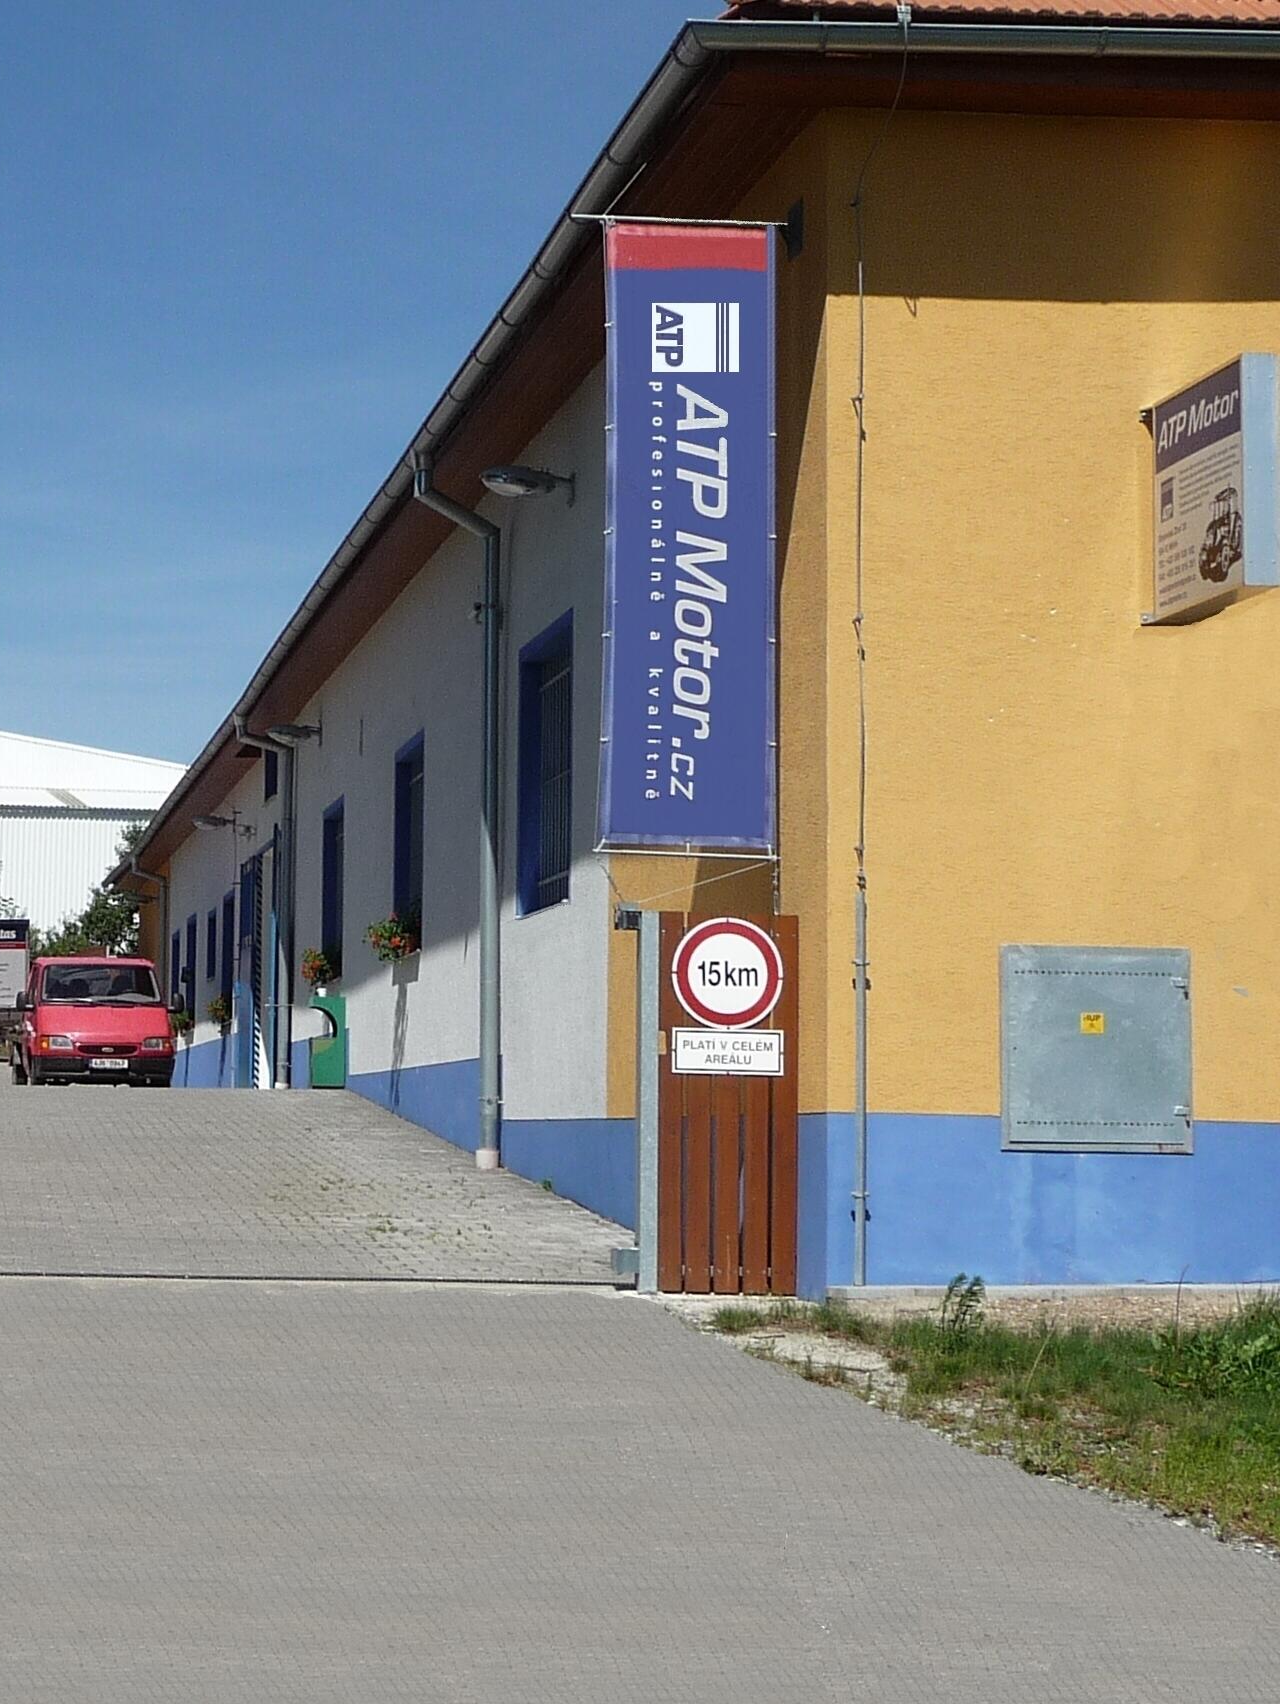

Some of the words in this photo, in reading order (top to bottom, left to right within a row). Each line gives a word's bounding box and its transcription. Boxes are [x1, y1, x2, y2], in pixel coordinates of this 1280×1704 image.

[655, 304, 684, 367] ATP
[676, 383, 729, 519] ATP
[1157, 409, 1187, 454] ATP
[1187, 389, 1240, 438] Motor
[648, 381, 667, 602] profesionálně
[649, 631, 662, 641] a
[645, 668, 663, 800] kvalitně
[682, 1038, 716, 1051] PLATÍ
[720, 1041, 728, 1050] V
[732, 1038, 774, 1052] CELÉM
[704, 1051, 752, 1065] AREÁLU
